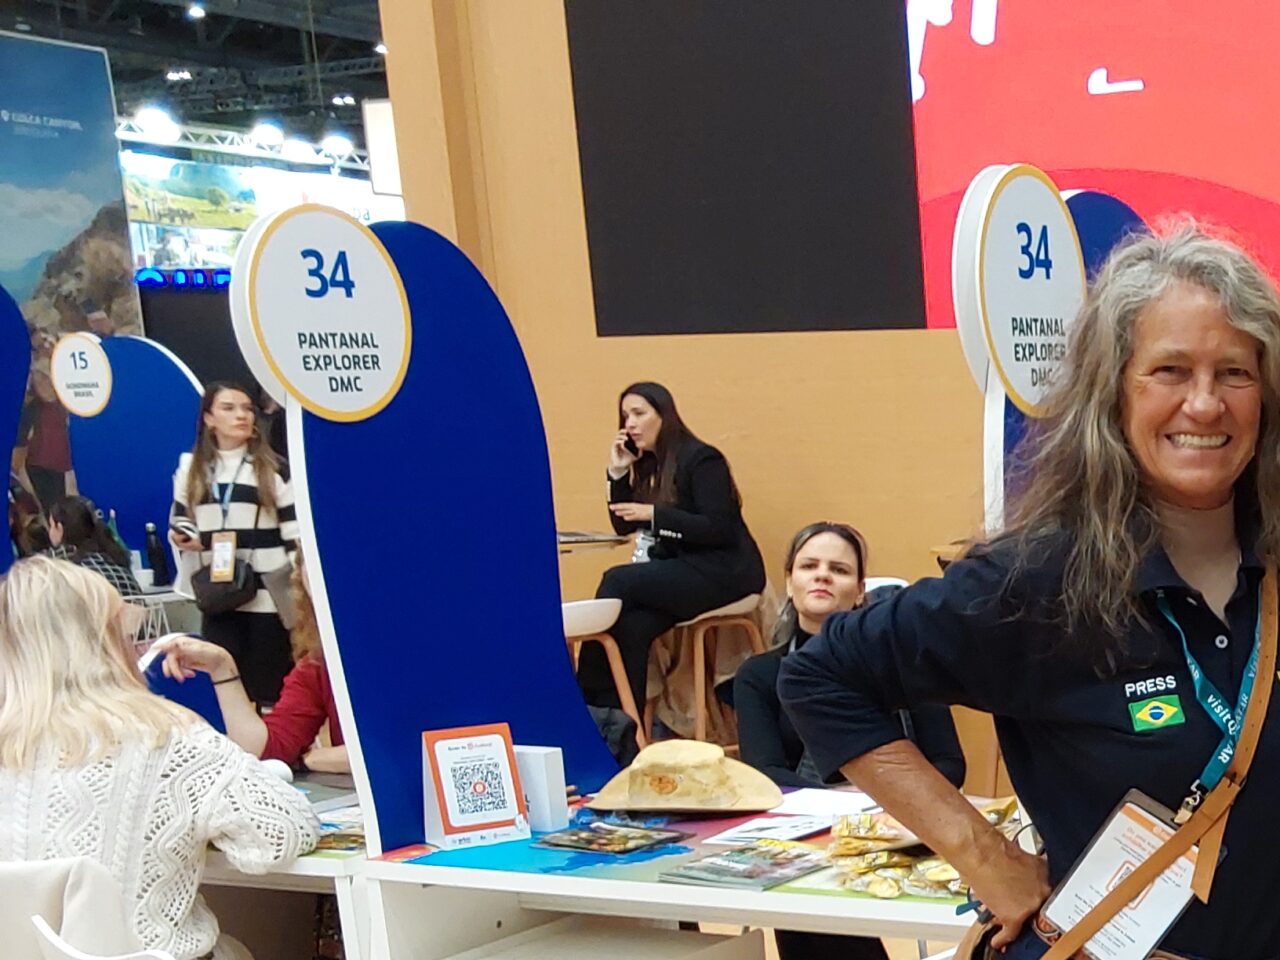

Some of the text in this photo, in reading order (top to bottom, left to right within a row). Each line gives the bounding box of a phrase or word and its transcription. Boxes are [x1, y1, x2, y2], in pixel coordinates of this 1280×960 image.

[1016, 222, 1053, 279] 34
[300, 249, 355, 298] 34
[1011, 316, 1066, 337] PANTANAL
[297, 332, 379, 349] PANTANAL
[70, 351, 88, 370] 15
[302, 354, 381, 371] EXPLORER
[328, 375, 363, 392] DMC
[1125, 675, 1176, 697] PRESS
